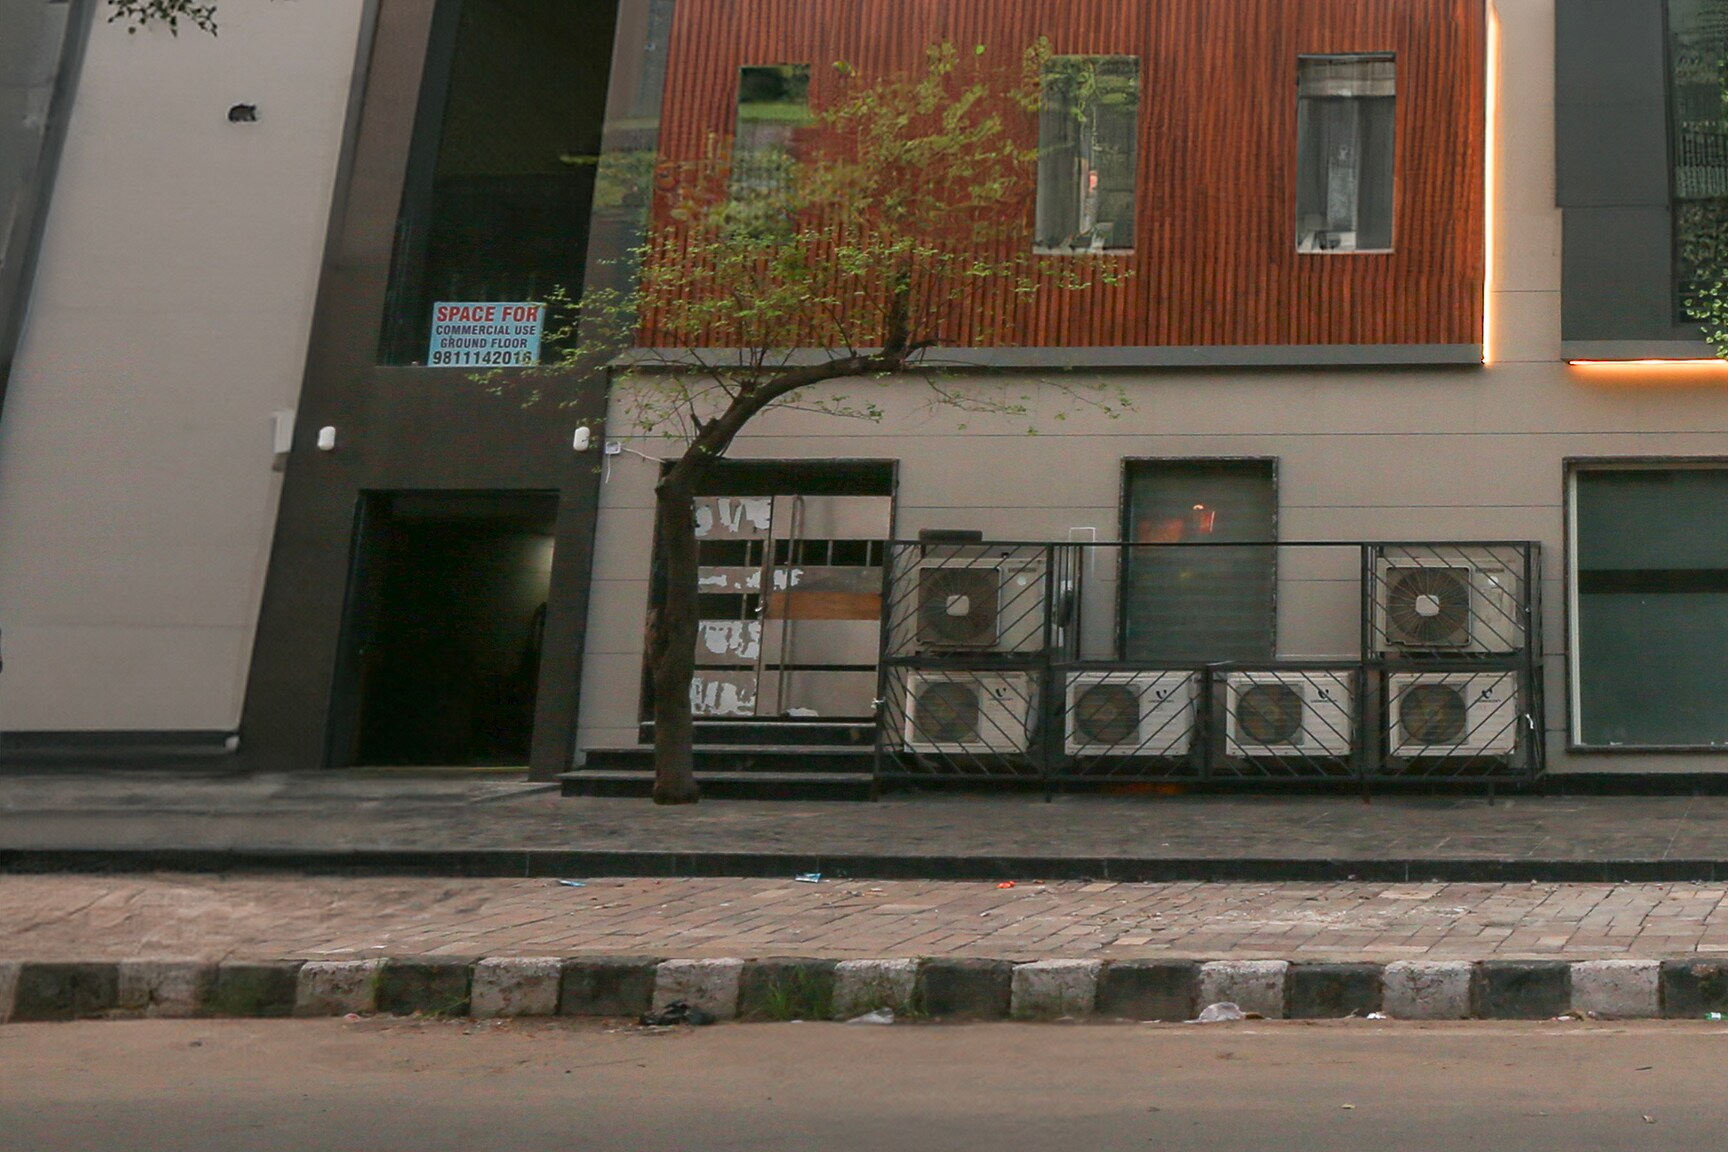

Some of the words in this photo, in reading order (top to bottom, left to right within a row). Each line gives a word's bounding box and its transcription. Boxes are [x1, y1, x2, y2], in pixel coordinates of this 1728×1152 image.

[437, 306, 496, 322] SPACE
[501, 306, 538, 322] FOR
[436, 325, 510, 335] COMMERCIAL
[514, 325, 536, 335] USE
[440, 338, 487, 348] GROUND
[491, 338, 528, 348] FLOOR
